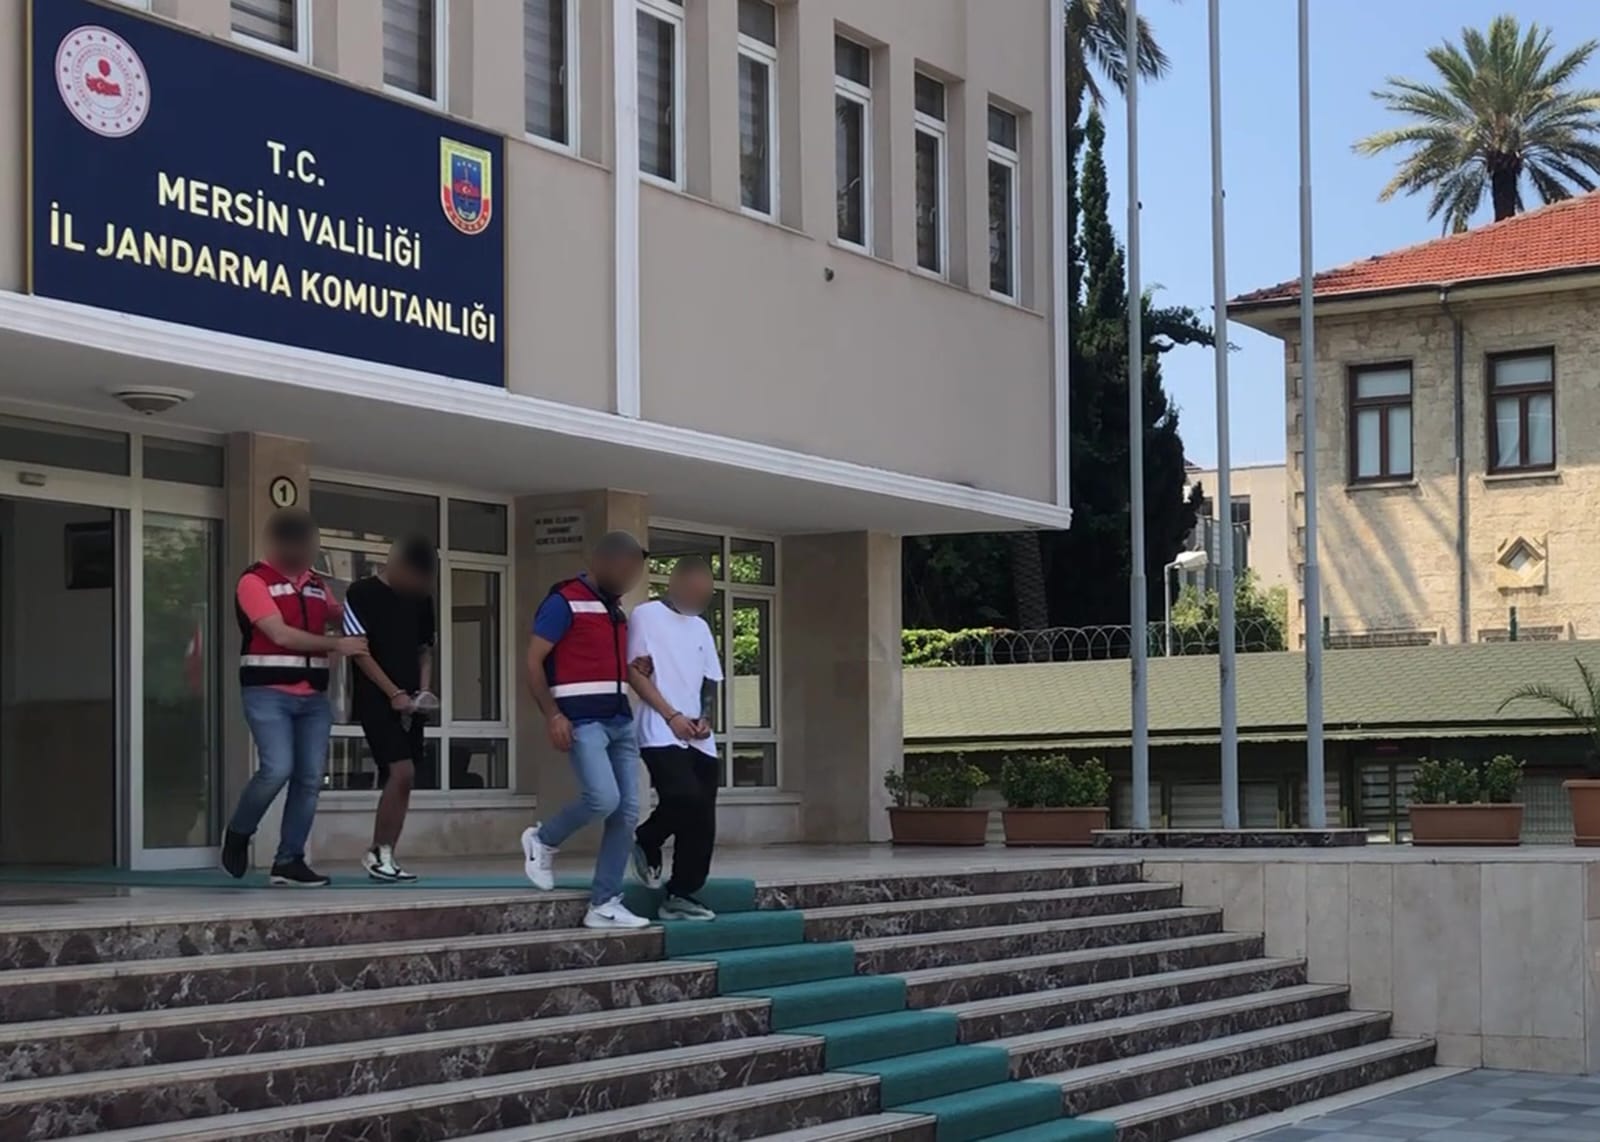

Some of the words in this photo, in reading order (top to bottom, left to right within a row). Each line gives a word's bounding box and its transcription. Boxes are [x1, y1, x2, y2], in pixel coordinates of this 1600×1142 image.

[266, 140, 325, 187] T.C.
[158, 171, 289, 237] MERSİN
[297, 208, 421, 270] VALİLİĞİ
[50, 201, 86, 252] İL
[96, 223, 292, 298] JANDARMA
[301, 269, 496, 343] KOMUTANLIĞI
[279, 484, 287, 502] 1
